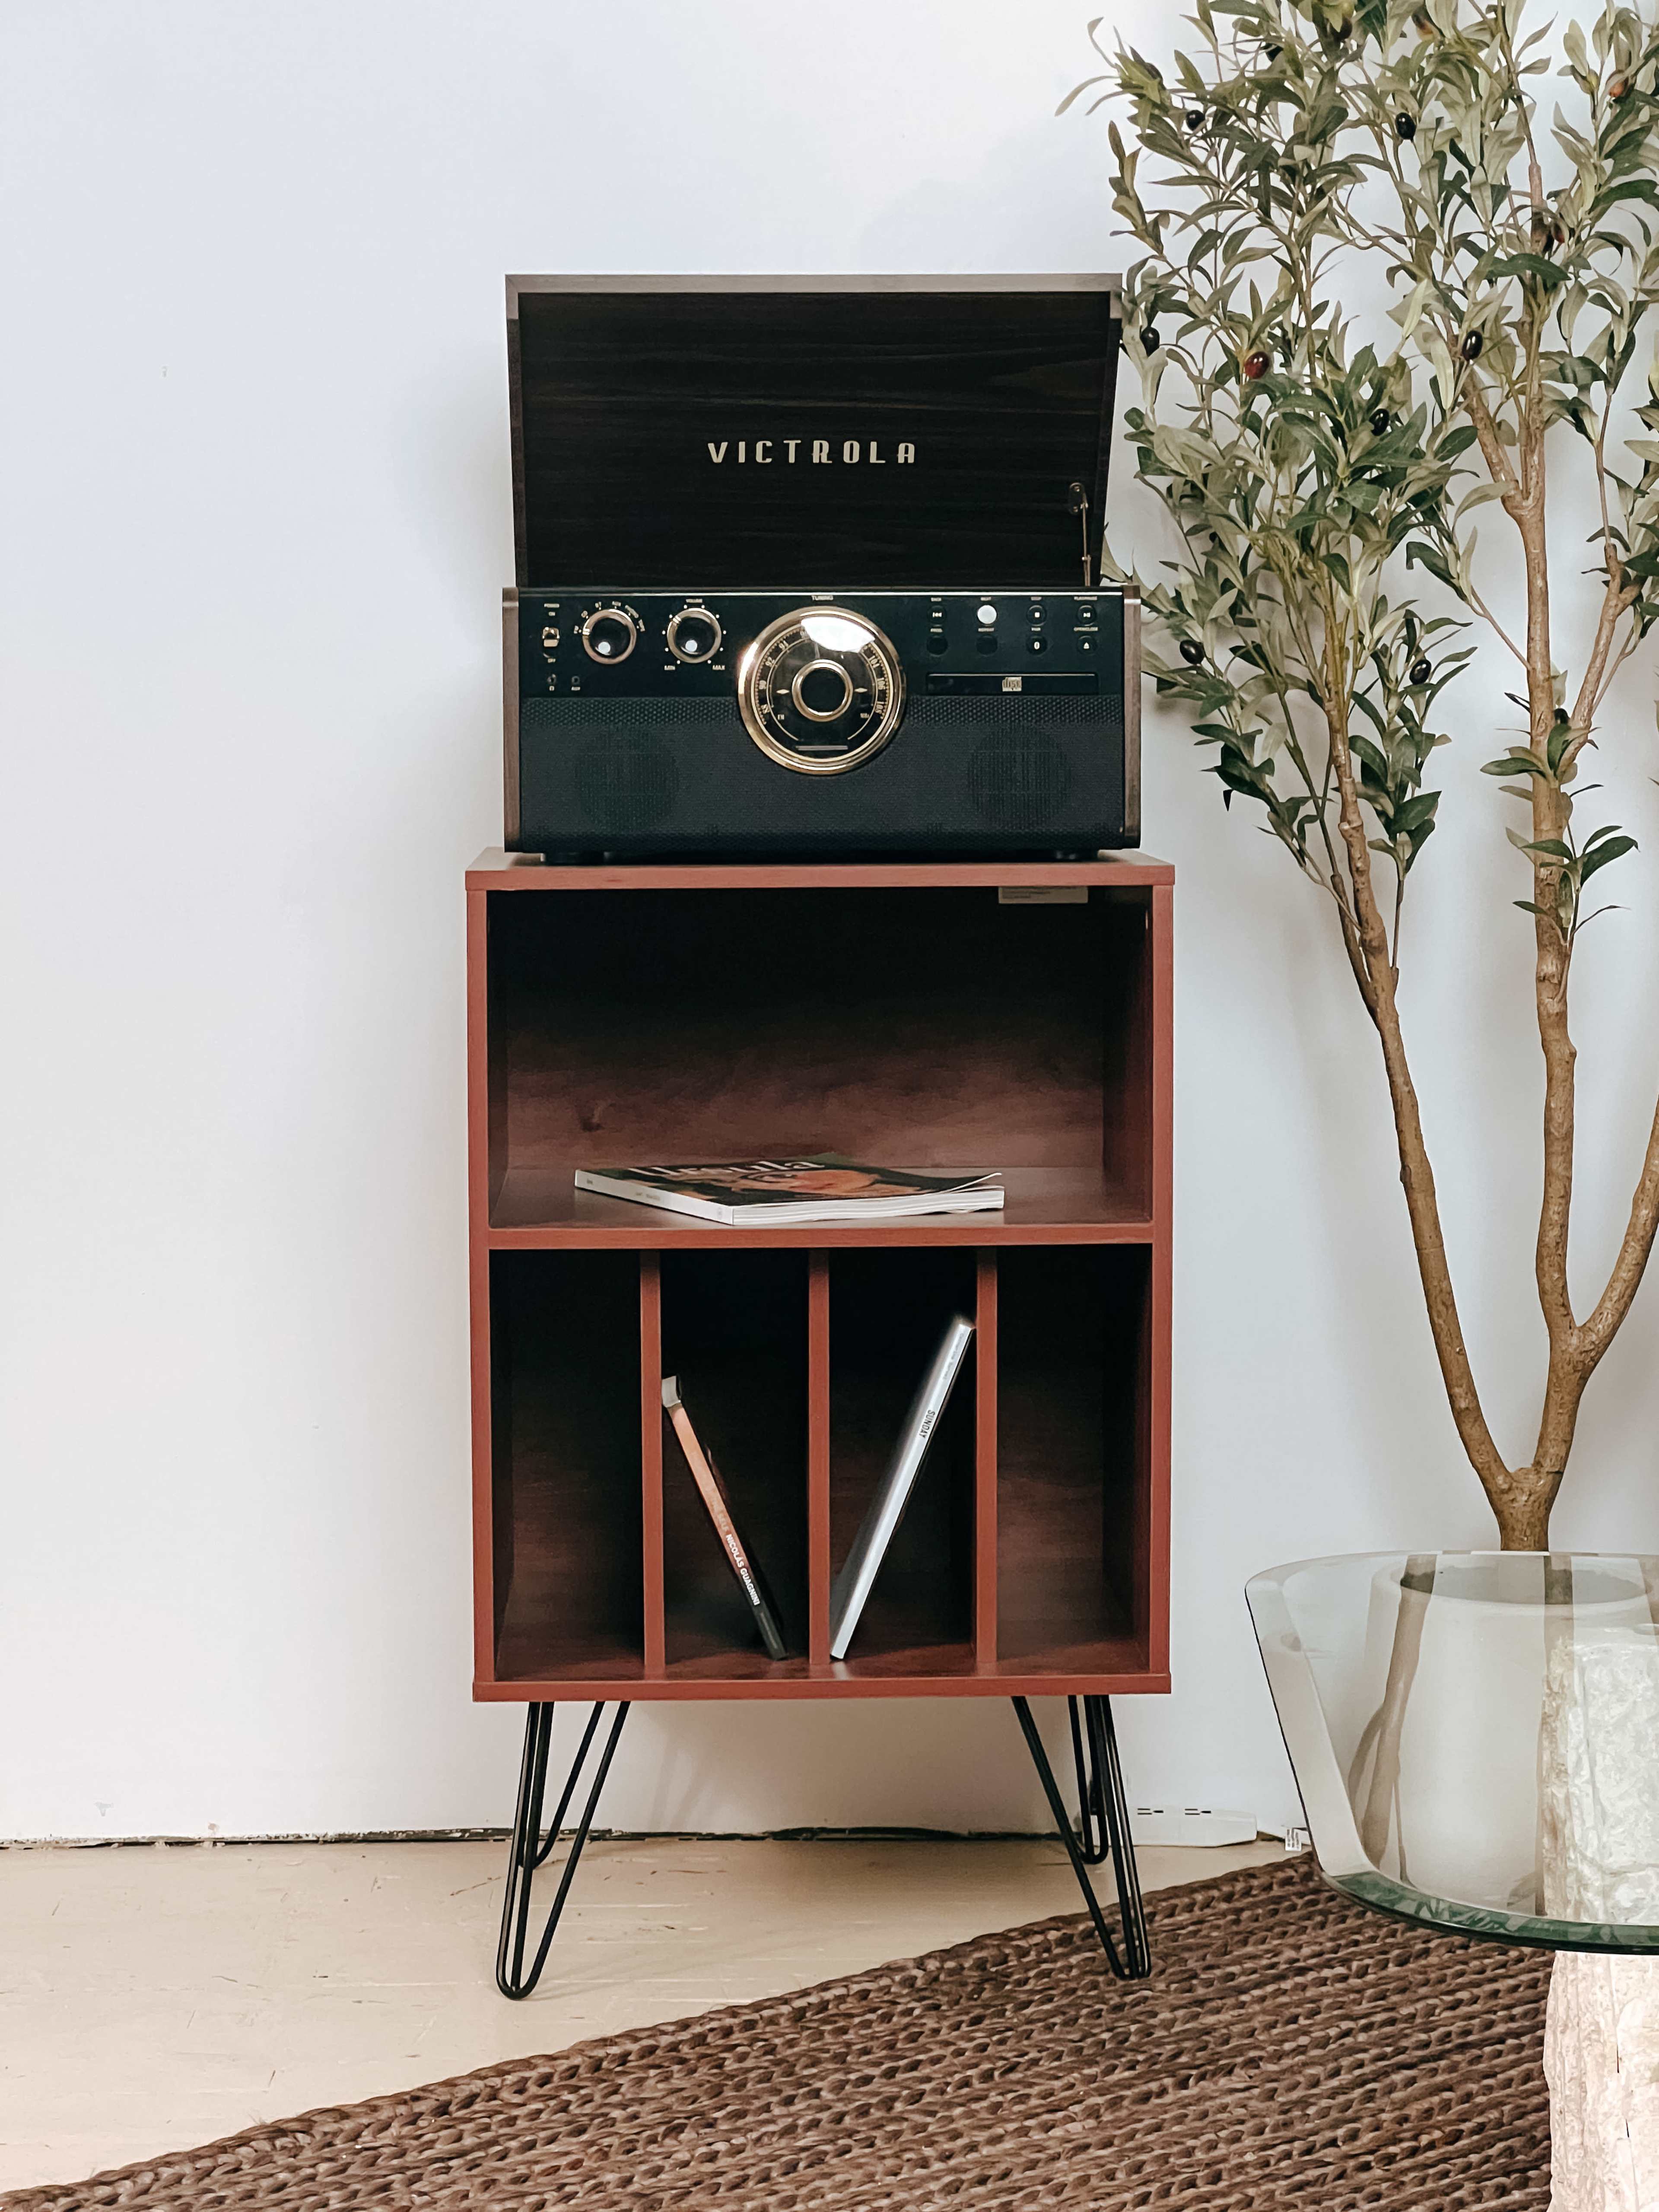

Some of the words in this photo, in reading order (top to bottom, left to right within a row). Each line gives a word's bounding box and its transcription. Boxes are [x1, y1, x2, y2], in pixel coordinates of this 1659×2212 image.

[708, 440, 915, 463] VICTROLA
[765, 657, 775, 668] 92
[628, 1161, 825, 1176] Ursula
[919, 1410, 935, 1438] SUNDAY
[726, 1534, 744, 1567] NICOLÁS
[740, 1567, 760, 1605] GUAGNINI
